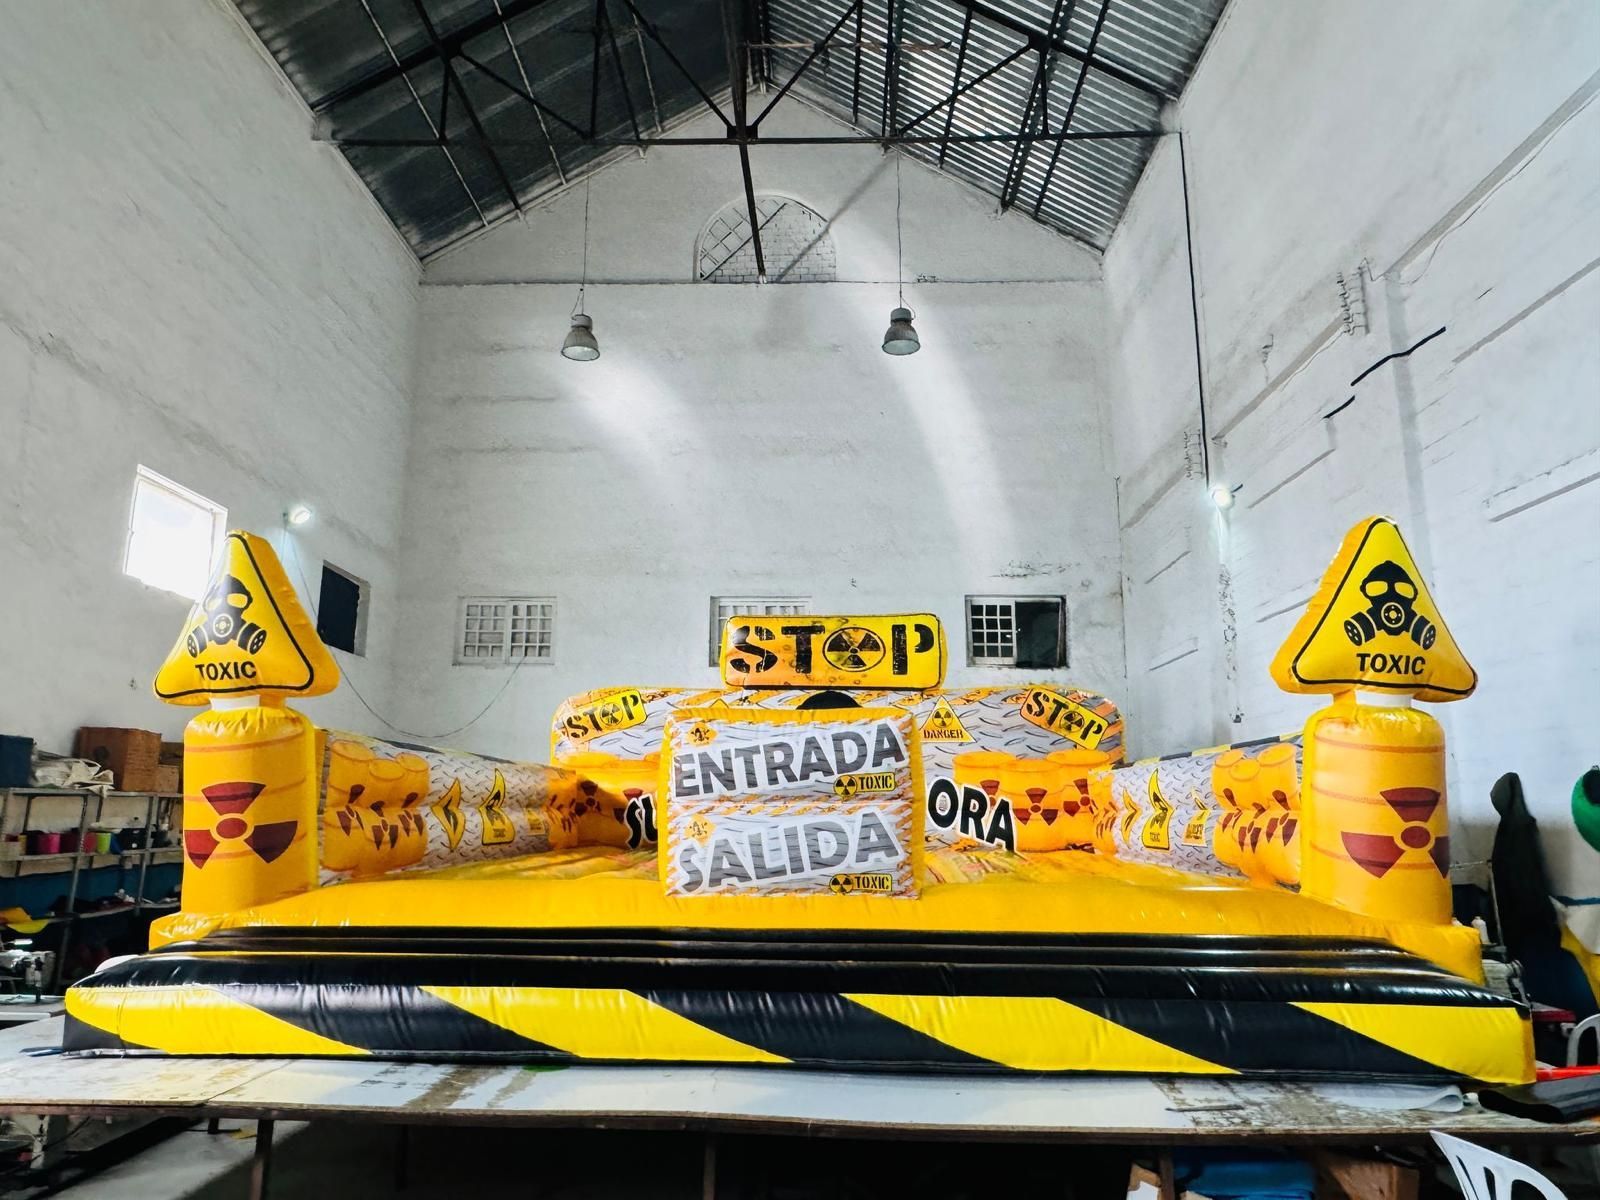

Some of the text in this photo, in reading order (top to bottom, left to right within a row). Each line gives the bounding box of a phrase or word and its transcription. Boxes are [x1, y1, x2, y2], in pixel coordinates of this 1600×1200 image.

[195, 661, 257, 681] TOXIC
[1356, 653, 1426, 675] TOXIC
[923, 729, 963, 739] DANGER
[674, 723, 905, 797] ENTRADA
[858, 775, 893, 791] TOXIC
[679, 812, 899, 893] SALIDA
[855, 875, 890, 890] TOXIC
